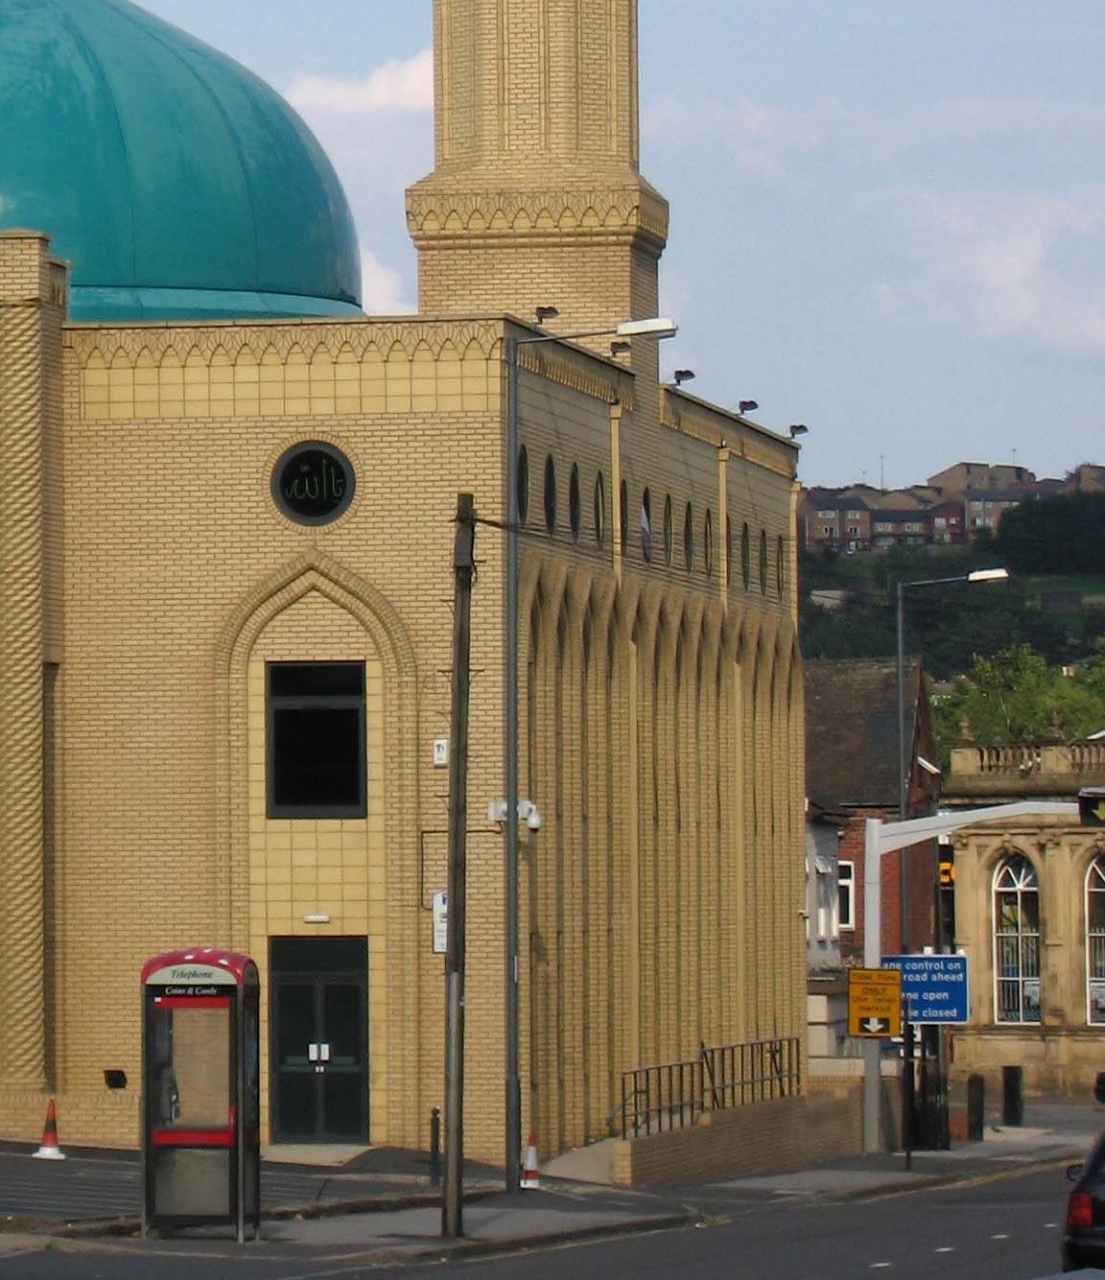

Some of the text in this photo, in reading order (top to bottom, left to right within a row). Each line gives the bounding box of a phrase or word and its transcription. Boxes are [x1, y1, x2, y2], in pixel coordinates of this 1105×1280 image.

[905, 960, 944, 970] control
[947, 962, 961, 970] on
[903, 972, 963, 982] road ahead
[922, 992, 949, 1002] open
[922, 1008, 957, 1018] closed
